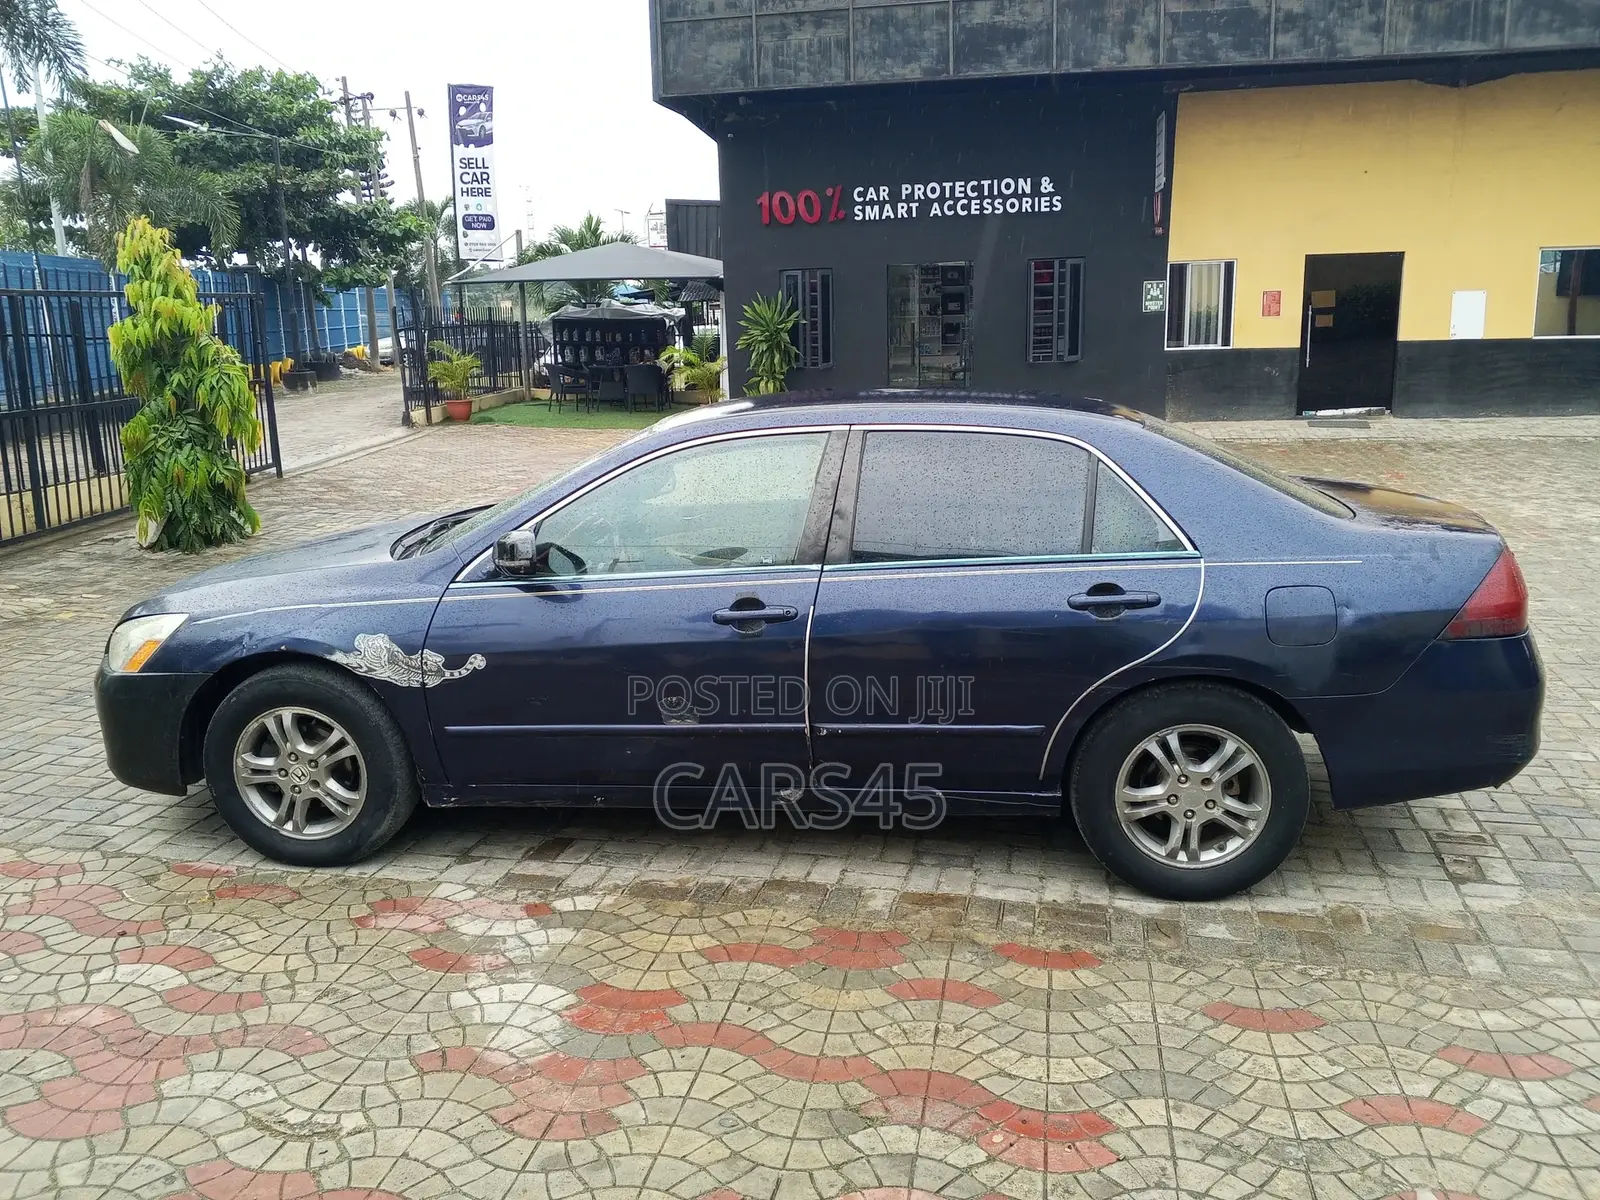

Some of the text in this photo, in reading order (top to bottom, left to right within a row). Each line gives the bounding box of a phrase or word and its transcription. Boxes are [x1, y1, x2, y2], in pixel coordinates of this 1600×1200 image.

[459, 157, 489, 169] SELL
[460, 171, 490, 185] CAR
[461, 187, 492, 197] HERE
[853, 176, 1055, 202] CAR PROTECTION &
[756, 184, 846, 225] 100%
[853, 195, 1062, 221] SMART ACCESSORIES
